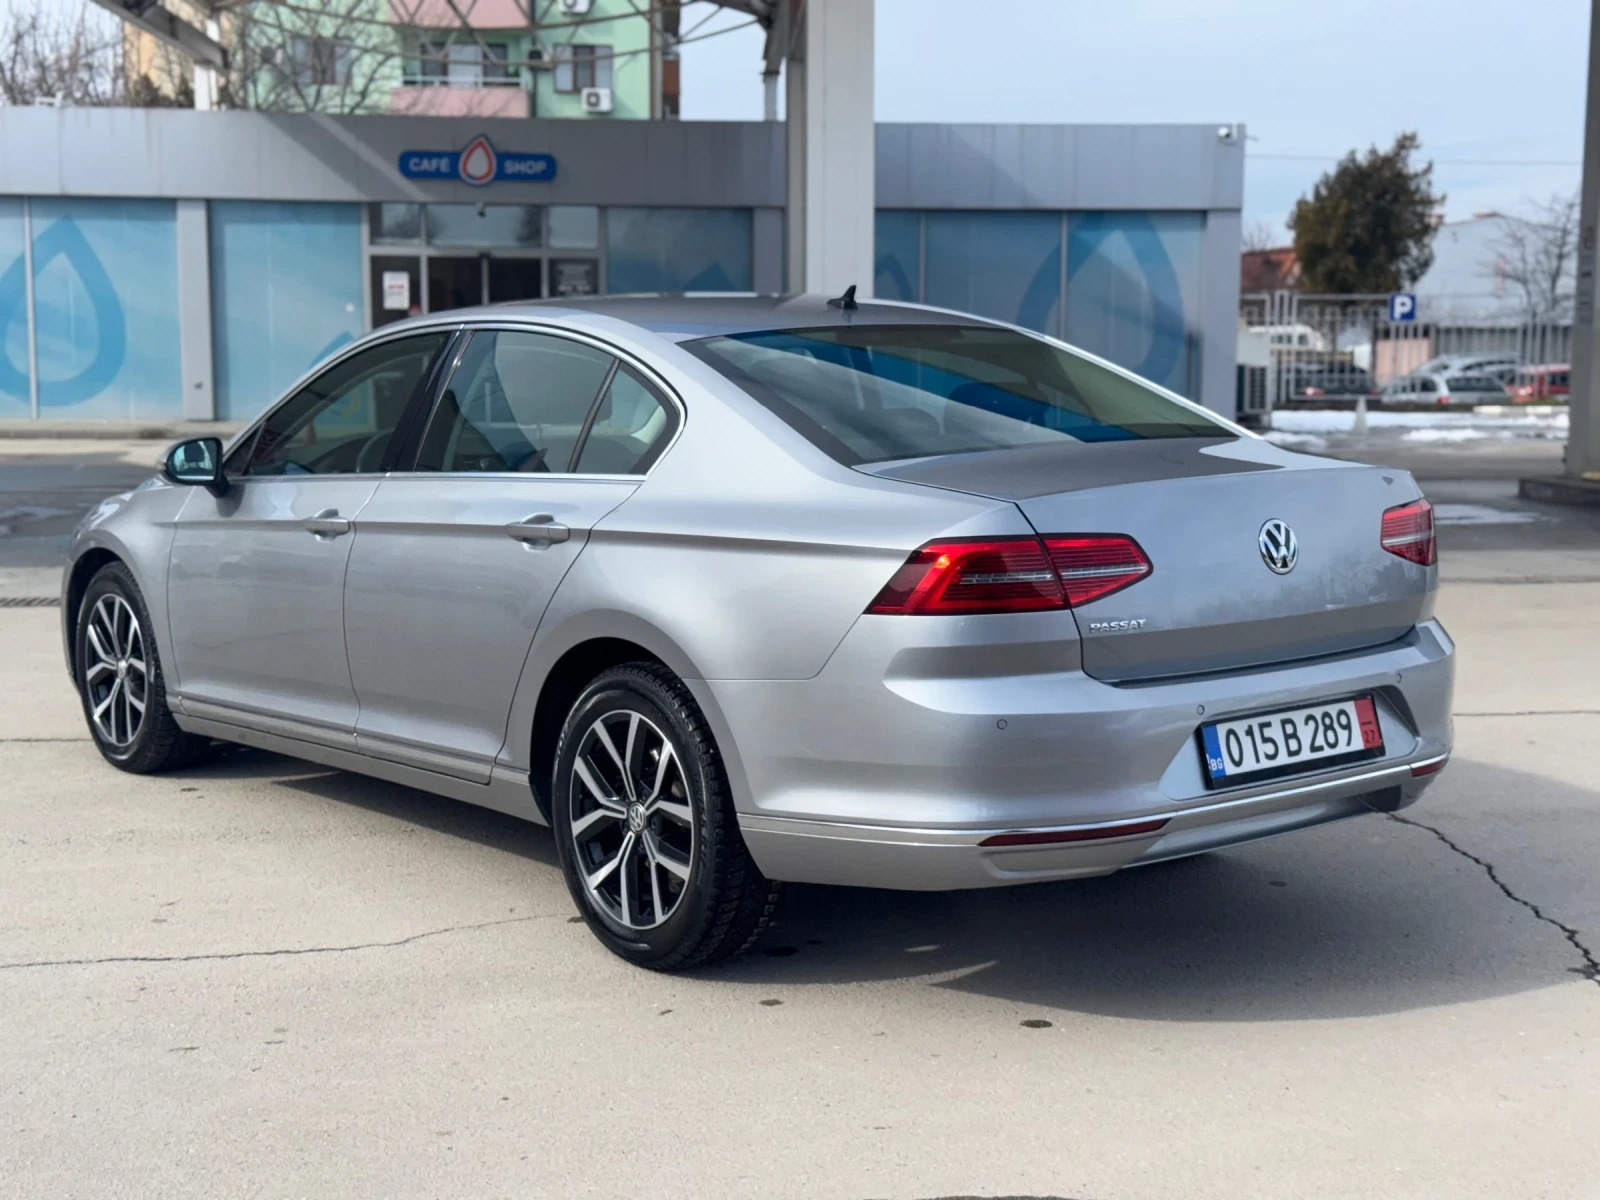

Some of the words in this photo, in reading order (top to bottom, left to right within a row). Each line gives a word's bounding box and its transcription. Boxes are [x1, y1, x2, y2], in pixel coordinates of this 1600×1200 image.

[504, 159, 547, 175] SHOP
[1394, 295, 1413, 319] P
[1260, 520, 1297, 572] VW
[1089, 618, 1147, 633] PASSAT
[1210, 757, 1223, 771] BG
